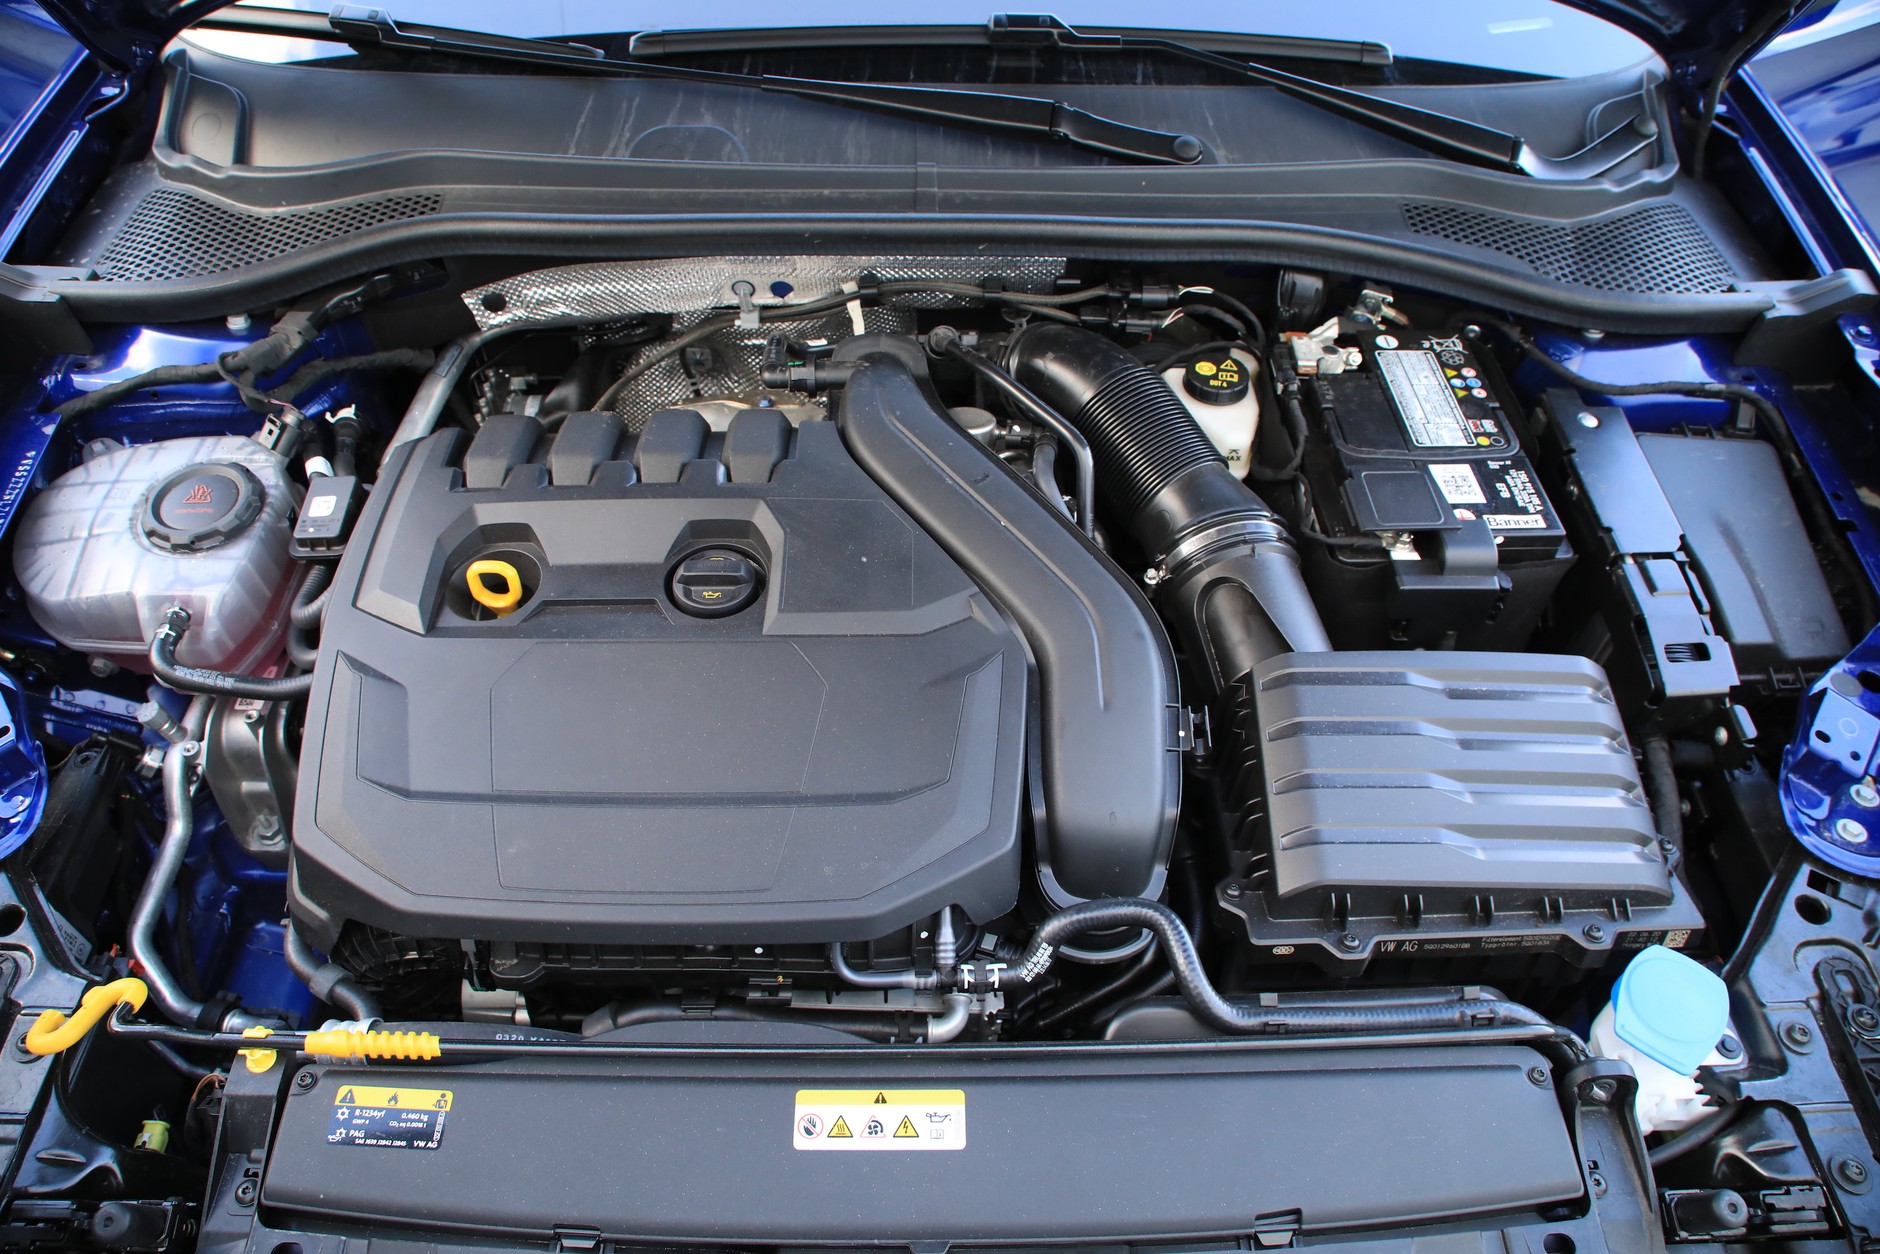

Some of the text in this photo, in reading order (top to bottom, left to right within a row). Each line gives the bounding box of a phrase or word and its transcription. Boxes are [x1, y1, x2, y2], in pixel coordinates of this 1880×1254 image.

[1209, 379, 1222, 387] DOT
[1495, 483, 1511, 498] EFB
[1486, 516, 1540, 526] Banner
[1380, 941, 1397, 952] VW
[1401, 940, 1419, 952] AG
[355, 1109, 429, 1122] R-1234yf 0.460 kg
[349, 1129, 366, 1138] PAG
[413, 1140, 425, 1148] VW
[426, 1141, 438, 1149] AG
